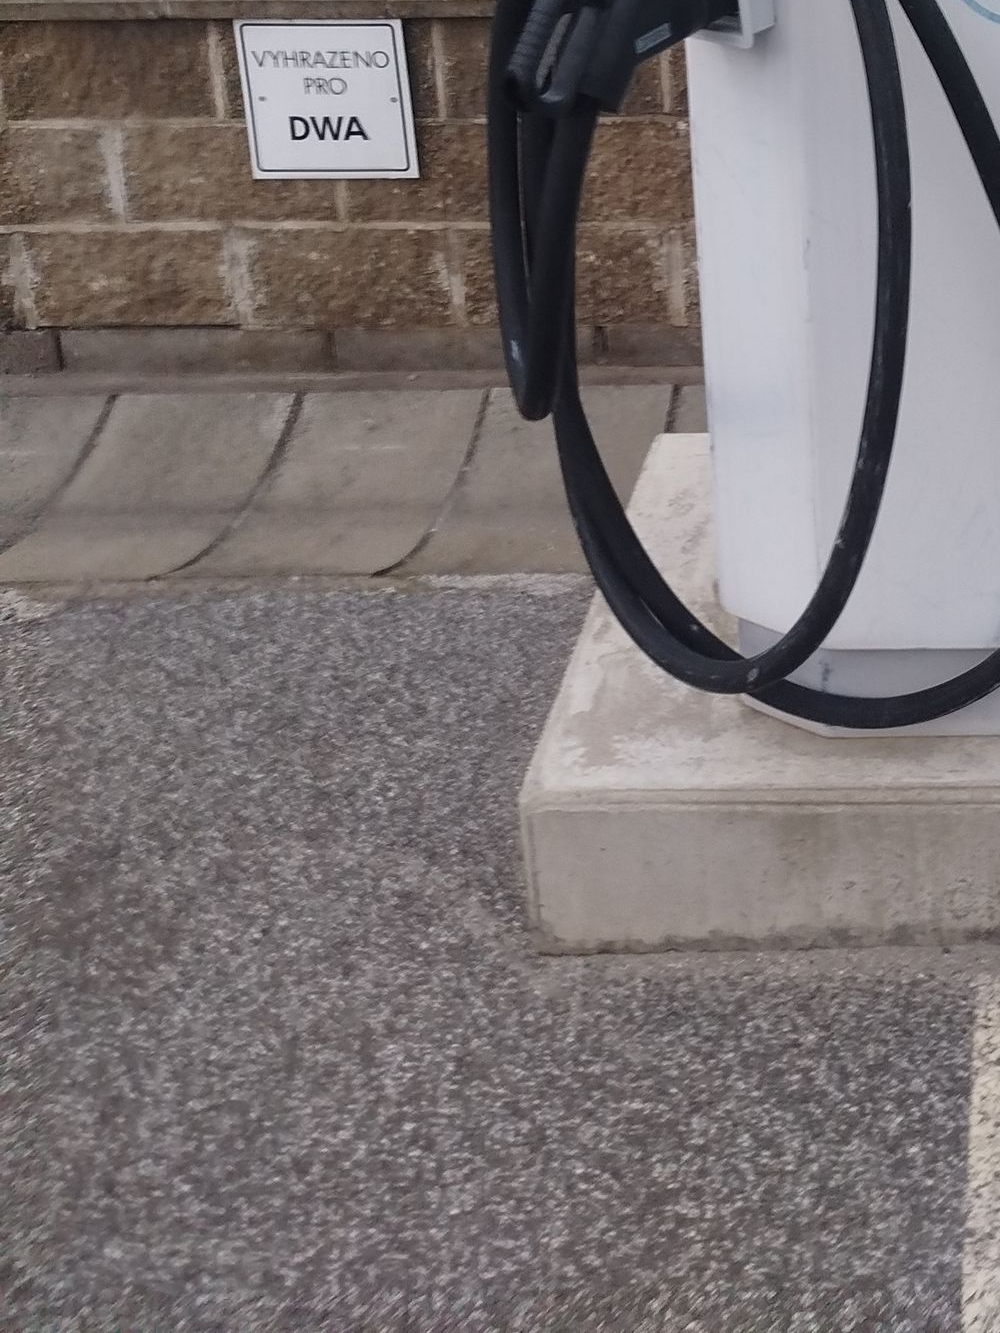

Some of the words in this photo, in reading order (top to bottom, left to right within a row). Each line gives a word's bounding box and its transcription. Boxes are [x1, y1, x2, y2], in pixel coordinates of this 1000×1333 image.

[251, 50, 390, 69] VYHRAZENO
[303, 77, 348, 95] PRO
[288, 116, 371, 140] DWA
